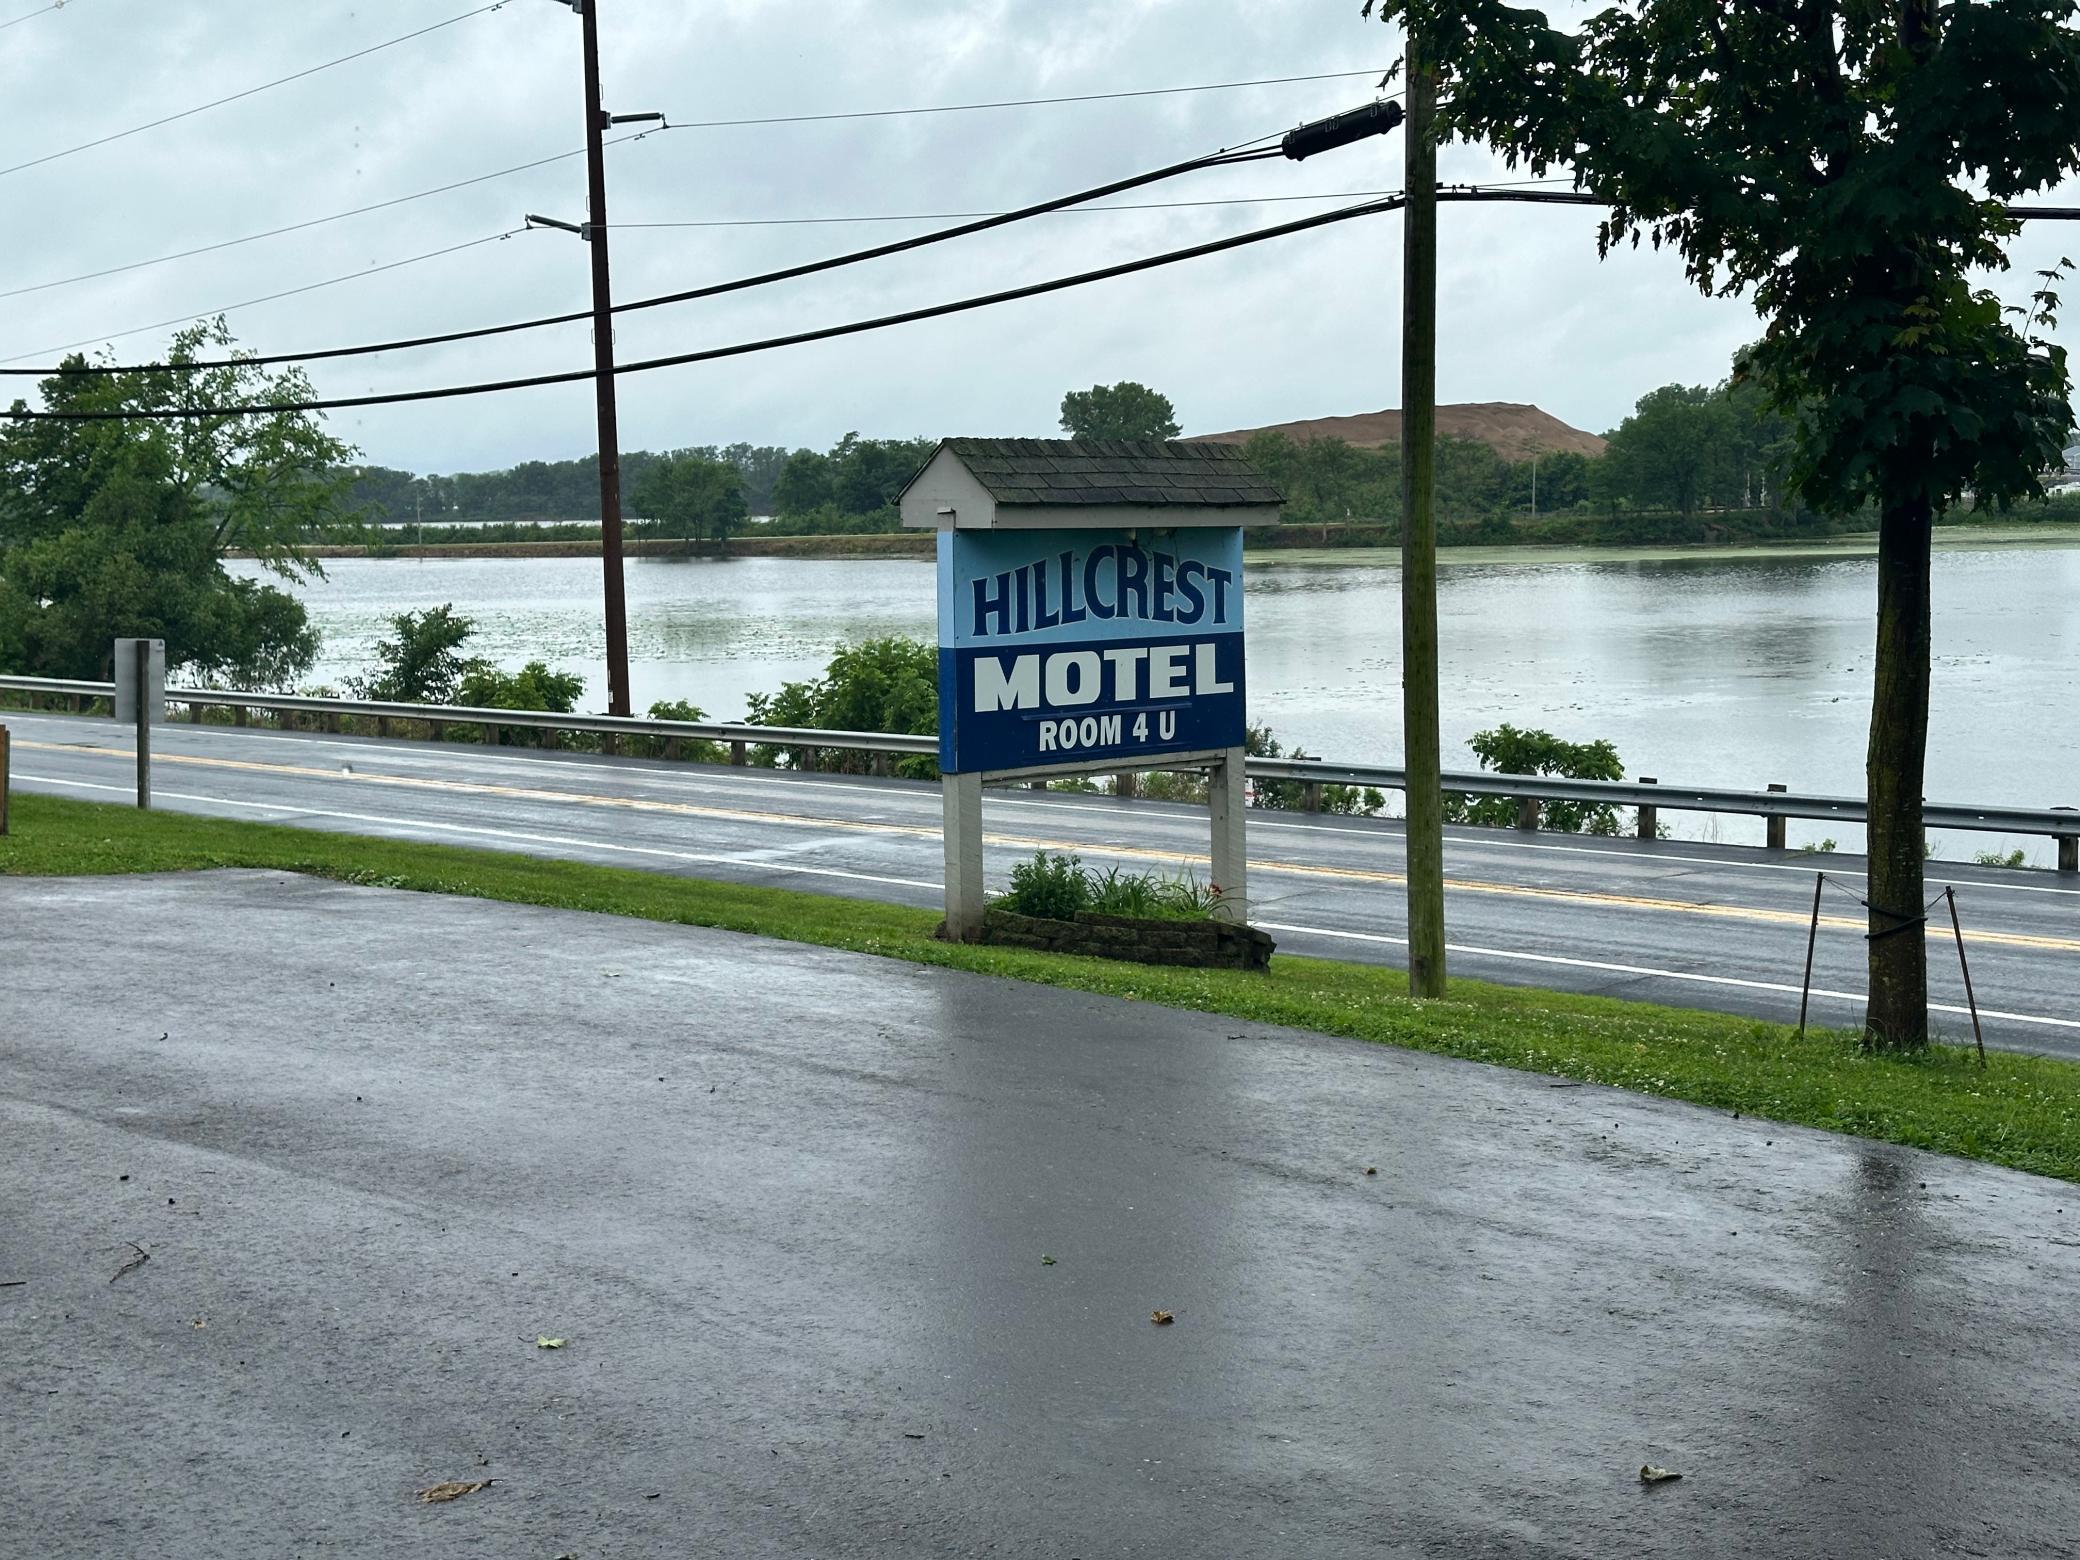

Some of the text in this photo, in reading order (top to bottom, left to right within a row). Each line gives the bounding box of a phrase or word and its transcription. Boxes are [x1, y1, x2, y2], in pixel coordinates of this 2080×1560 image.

[972, 545, 1232, 637] HILLCREST
[974, 643, 1234, 712] MOTEL
[1039, 710, 1176, 751] ROOM 4 U
